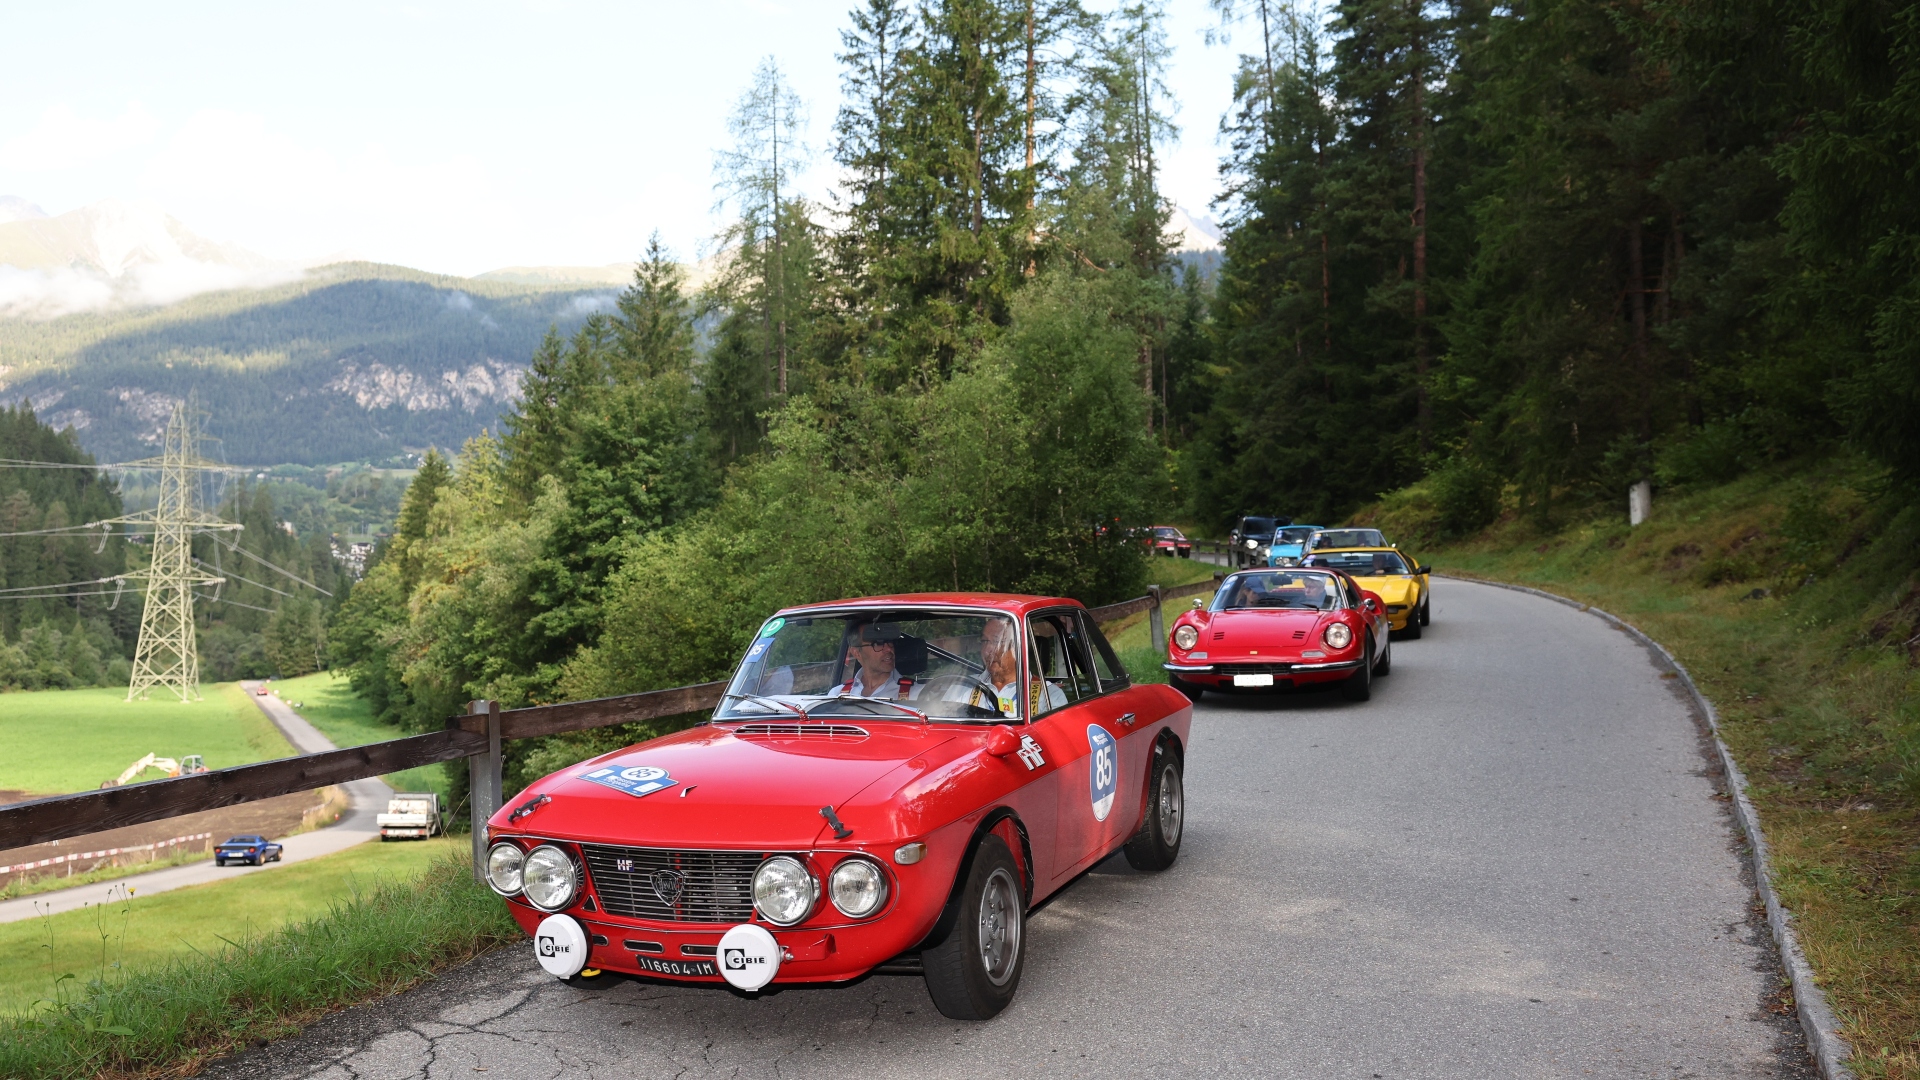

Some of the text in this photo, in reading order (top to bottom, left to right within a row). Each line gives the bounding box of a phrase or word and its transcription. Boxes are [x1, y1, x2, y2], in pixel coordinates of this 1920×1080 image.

[767, 621, 780, 631] D
[627, 768, 658, 778] 85
[1096, 746, 1111, 790] 85
[616, 858, 633, 871] HF
[641, 958, 691, 975] 116604
